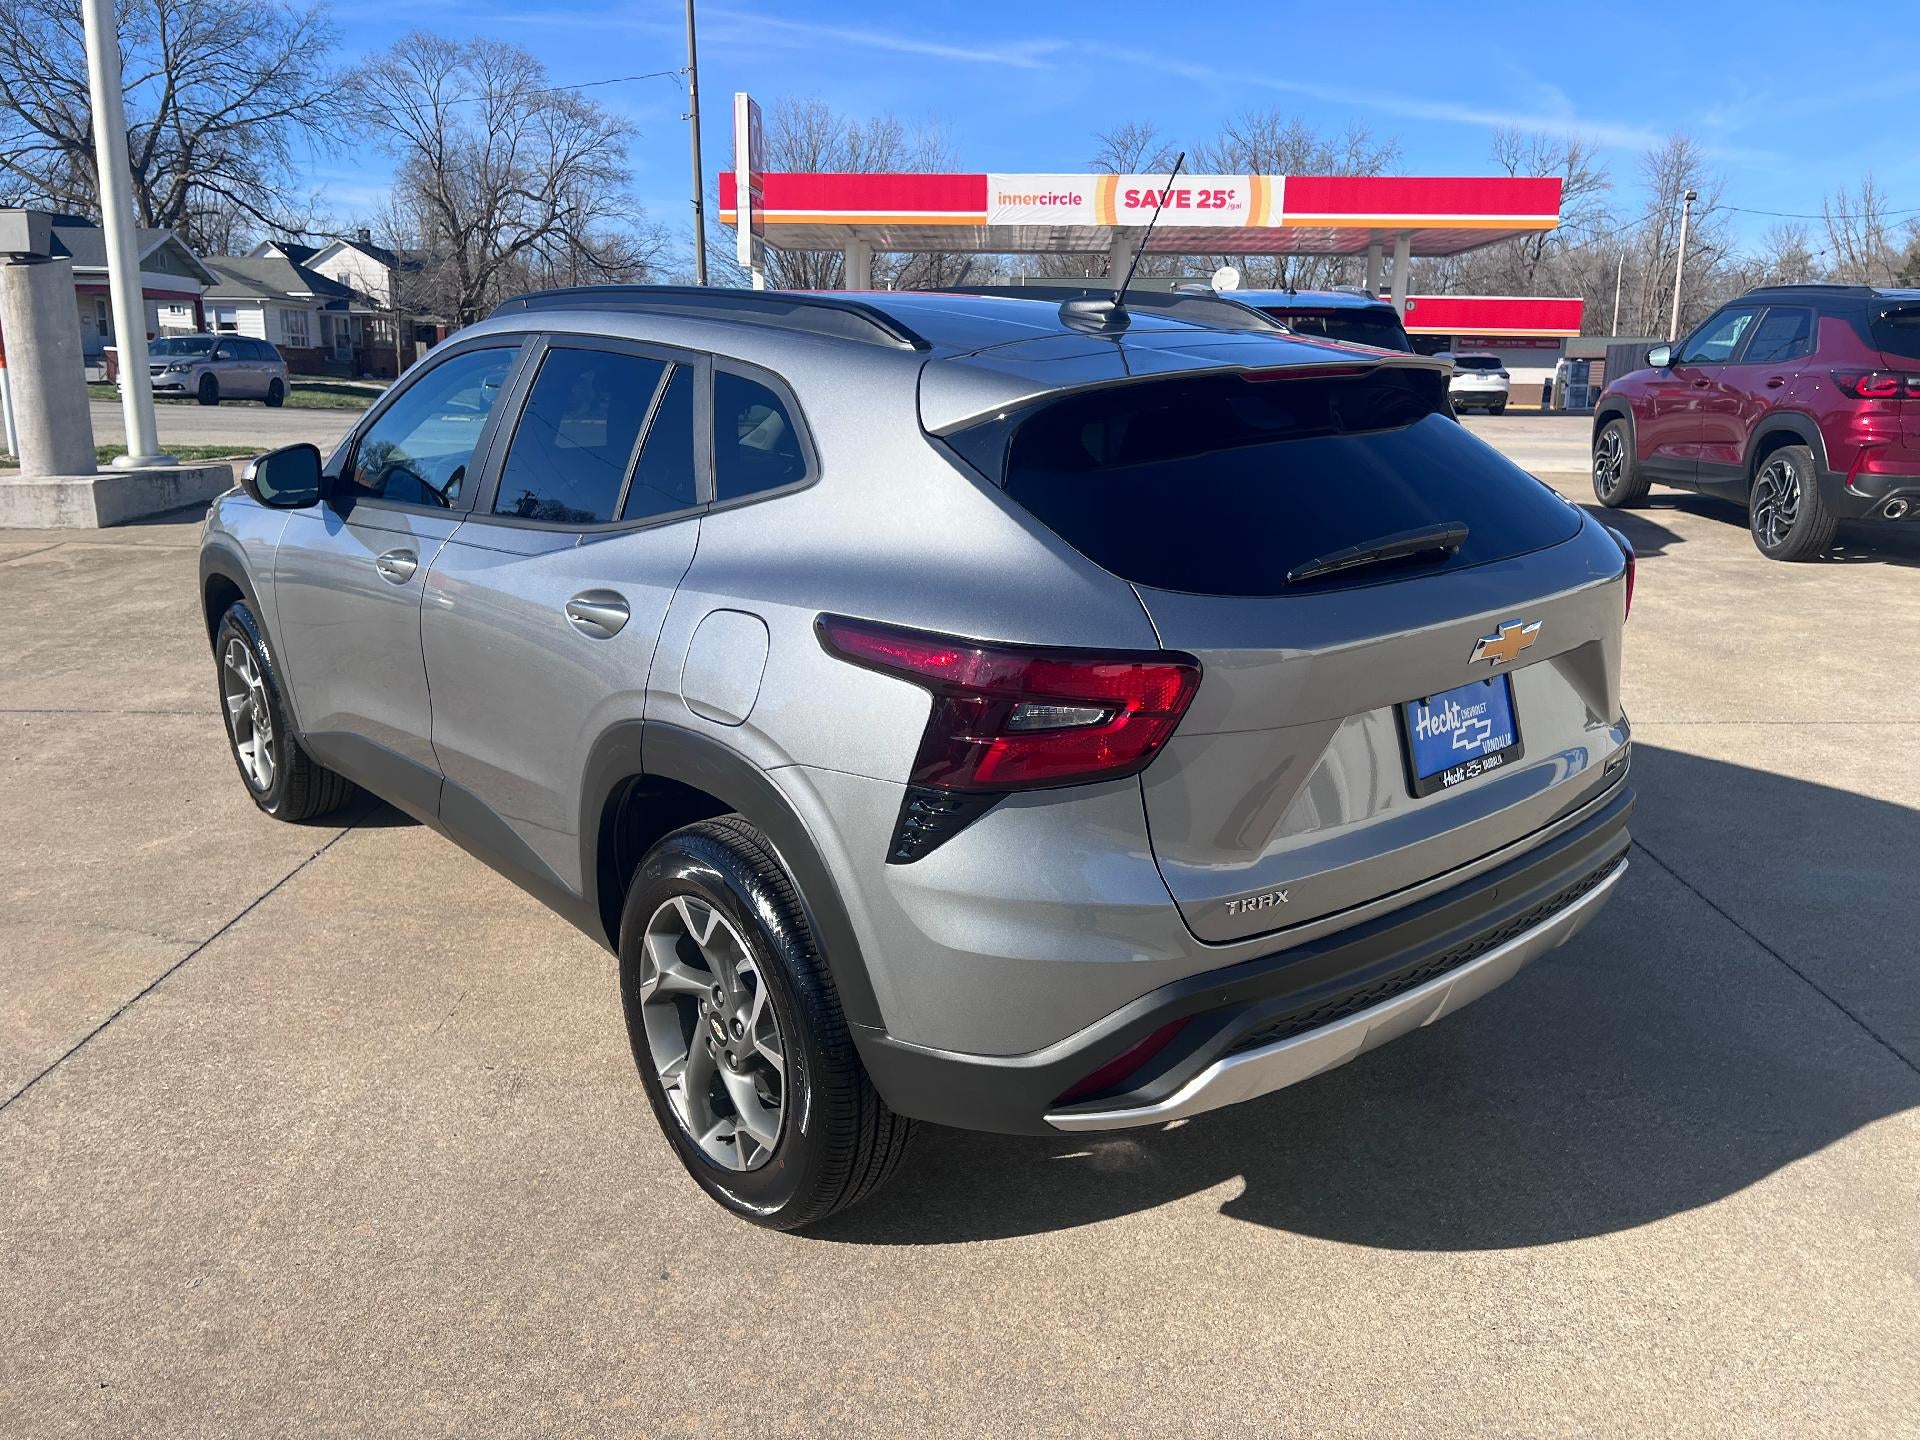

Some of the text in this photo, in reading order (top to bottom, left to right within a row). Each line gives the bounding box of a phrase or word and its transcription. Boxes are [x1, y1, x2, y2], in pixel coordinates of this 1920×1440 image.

[998, 191, 1082, 206] innercircle
[1124, 189, 1192, 209] SAVE
[1416, 699, 1461, 741] Hecht
[1460, 702, 1487, 720] CHEVROLET
[1482, 732, 1512, 754] VANDALIA
[1443, 767, 1465, 788] Hecht
[1224, 889, 1289, 916] TRAX
